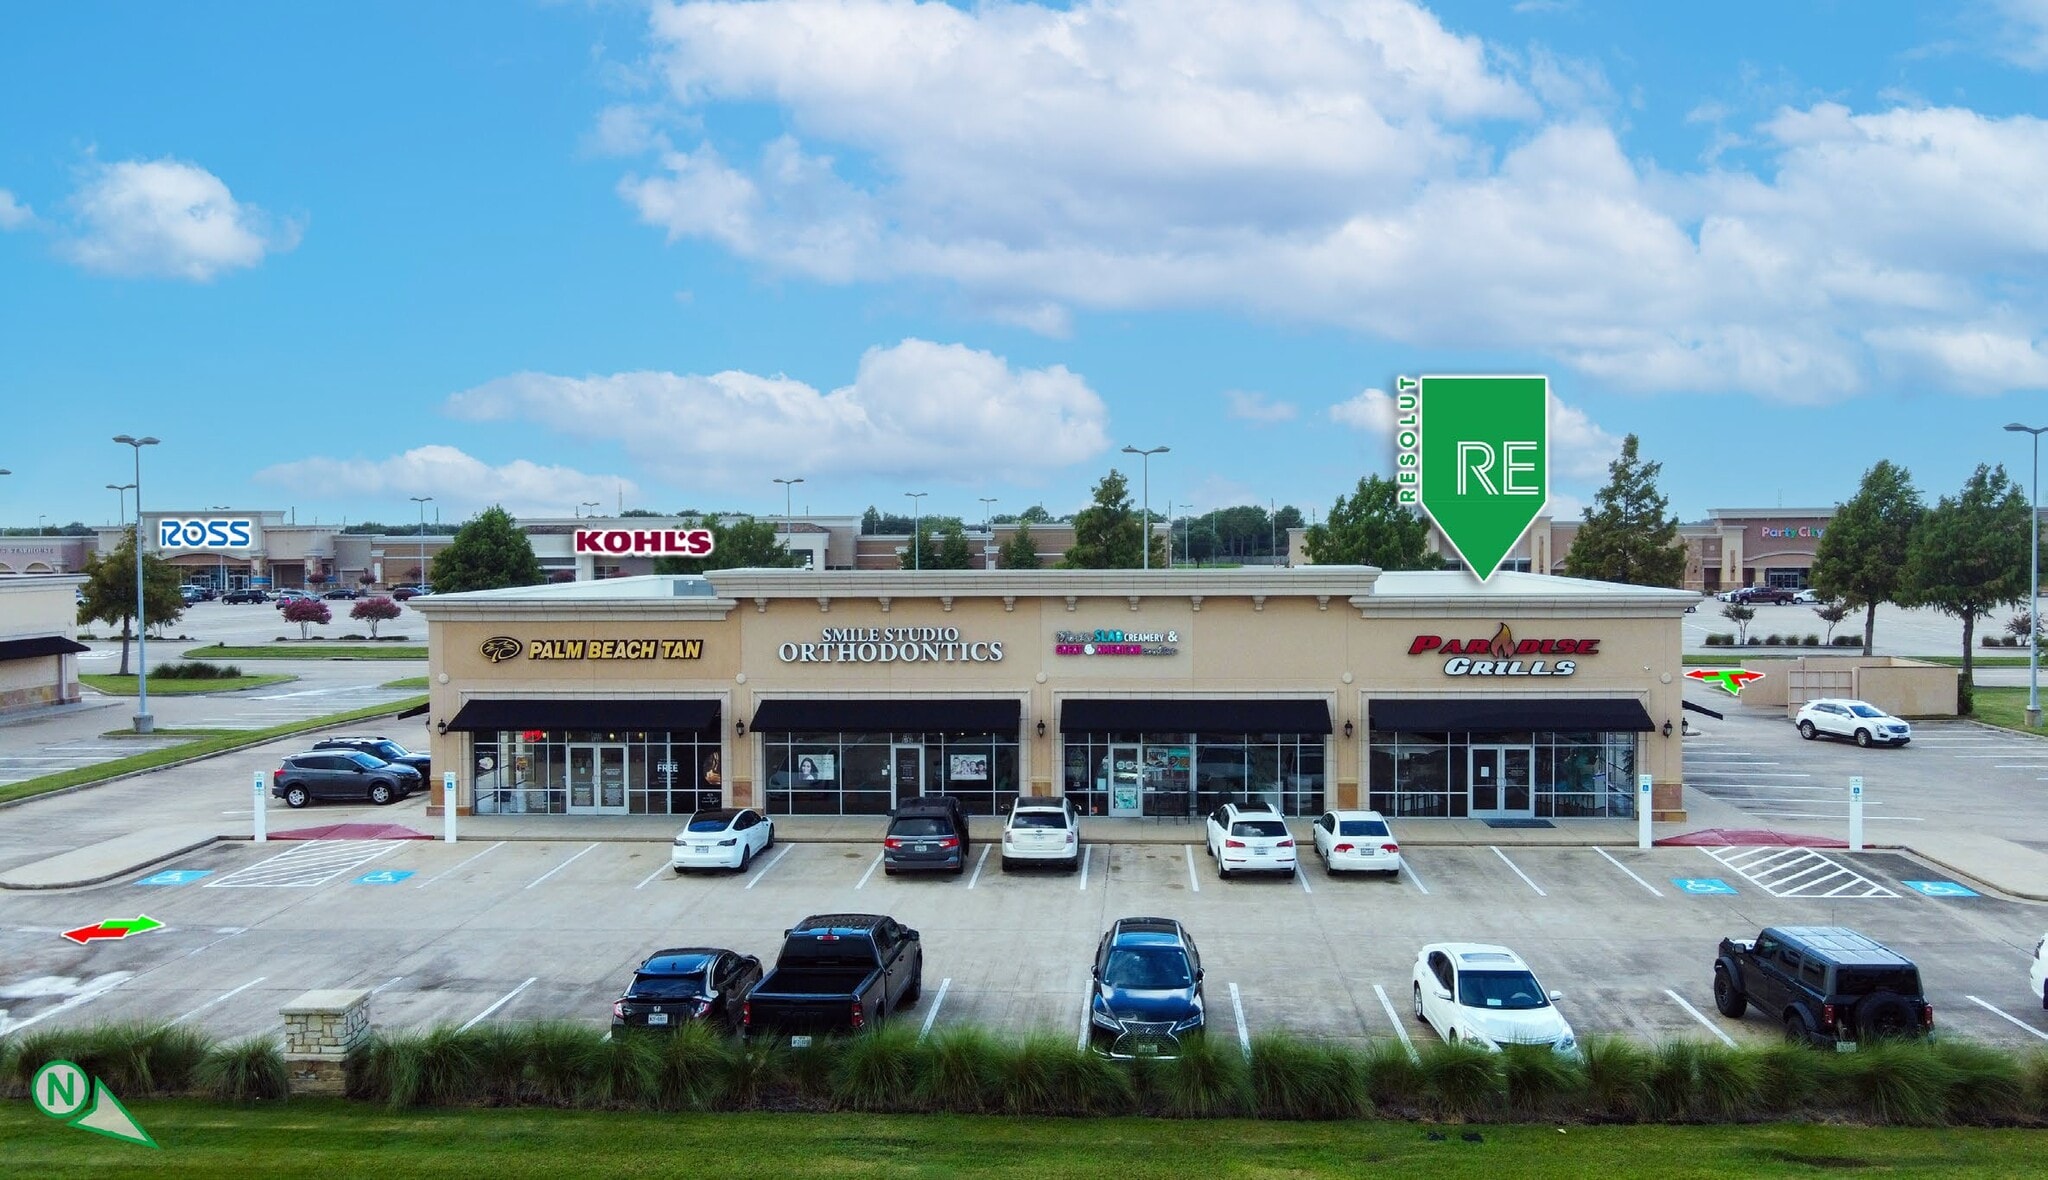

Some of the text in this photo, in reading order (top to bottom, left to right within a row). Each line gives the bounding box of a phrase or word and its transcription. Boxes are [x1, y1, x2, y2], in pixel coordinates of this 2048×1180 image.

[1761, 526, 1825, 539] Party City
[822, 627, 959, 642] SMILE STUDIO
[1094, 629, 1124, 642] SLAB
[1124, 633, 1164, 642] CREAMERY
[1168, 630, 1178, 642] &
[528, 639, 703, 659] PALM BEACH TAN
[778, 642, 1003, 662] ORTHODONTICS
[1444, 657, 1577, 676] GRILLS
[657, 763, 679, 773] FREE
